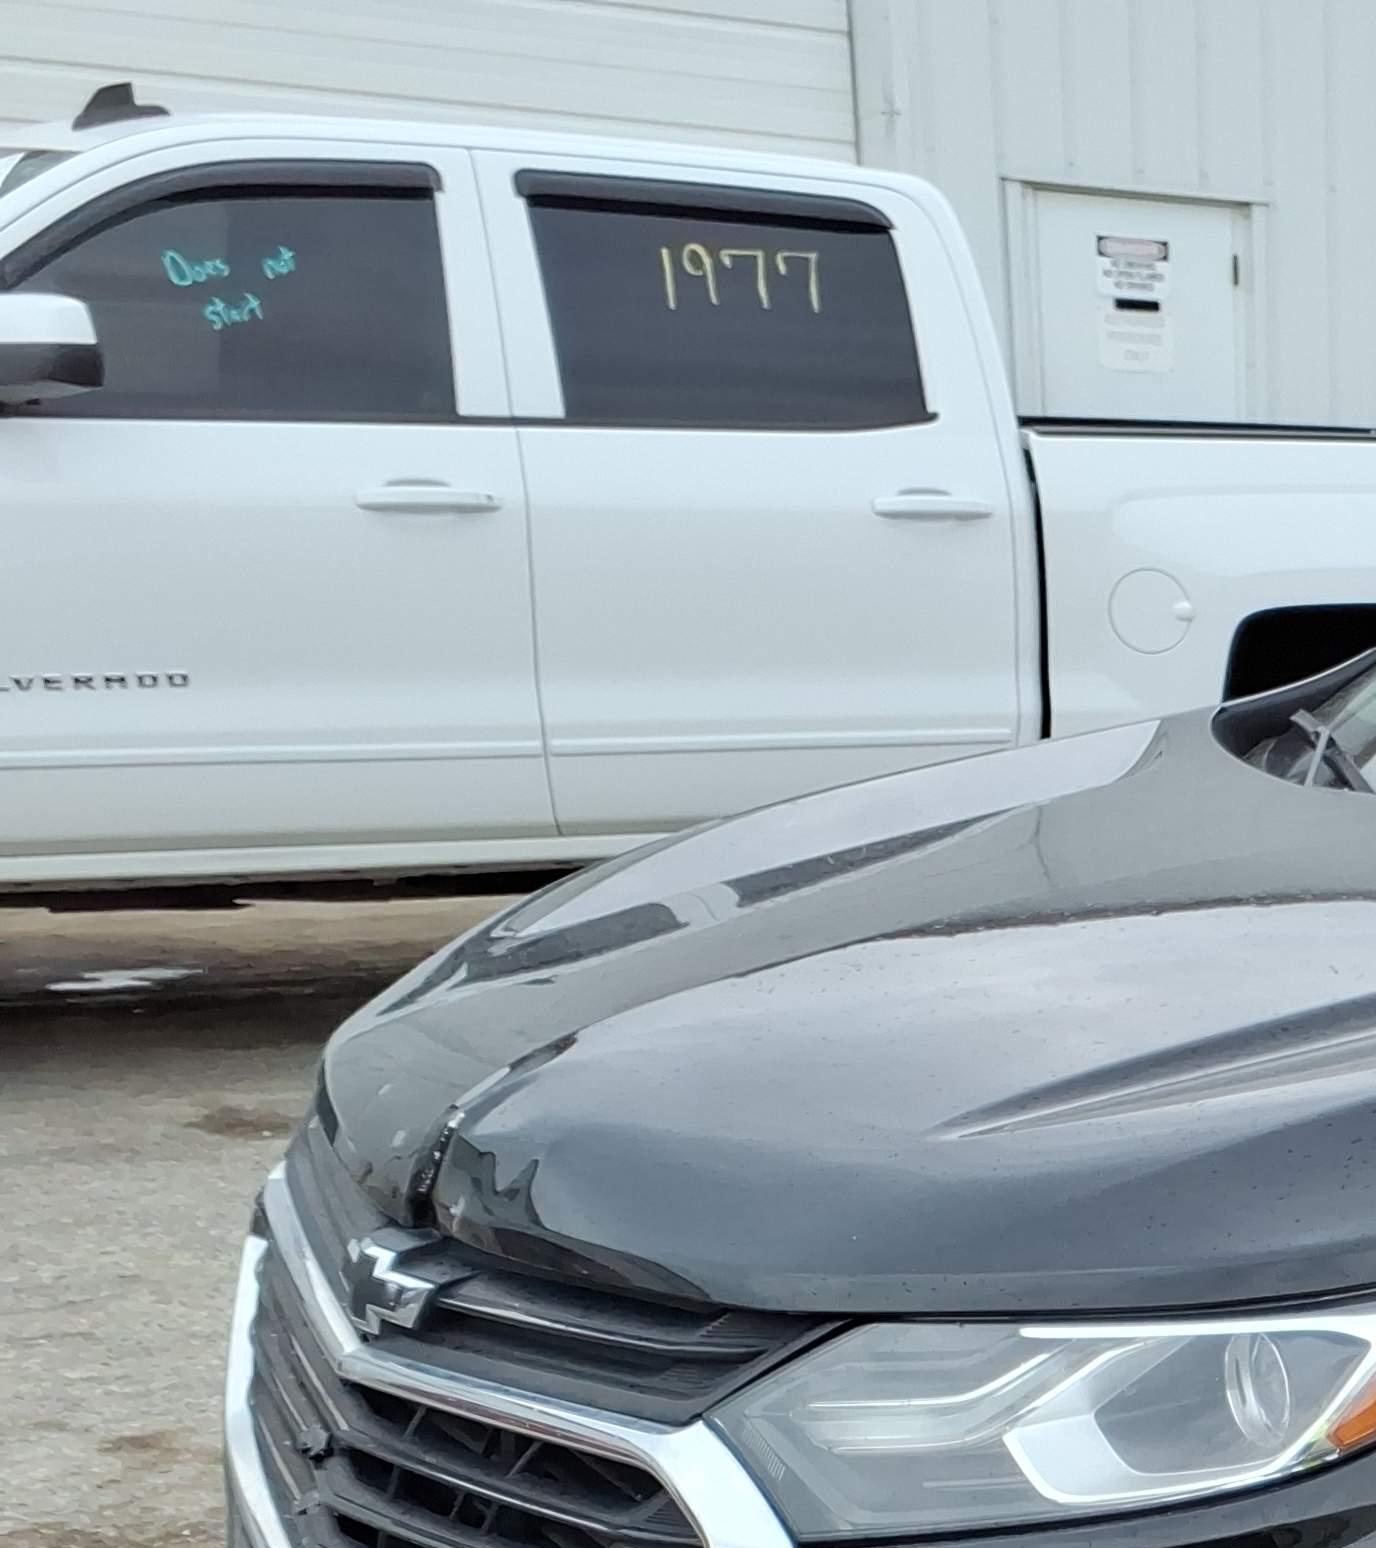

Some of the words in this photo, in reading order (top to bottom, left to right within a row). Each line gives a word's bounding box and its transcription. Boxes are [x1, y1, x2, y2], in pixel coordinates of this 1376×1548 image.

[161, 250, 230, 286] Does
[660, 243, 820, 313] 1977
[202, 292, 263, 330] start
